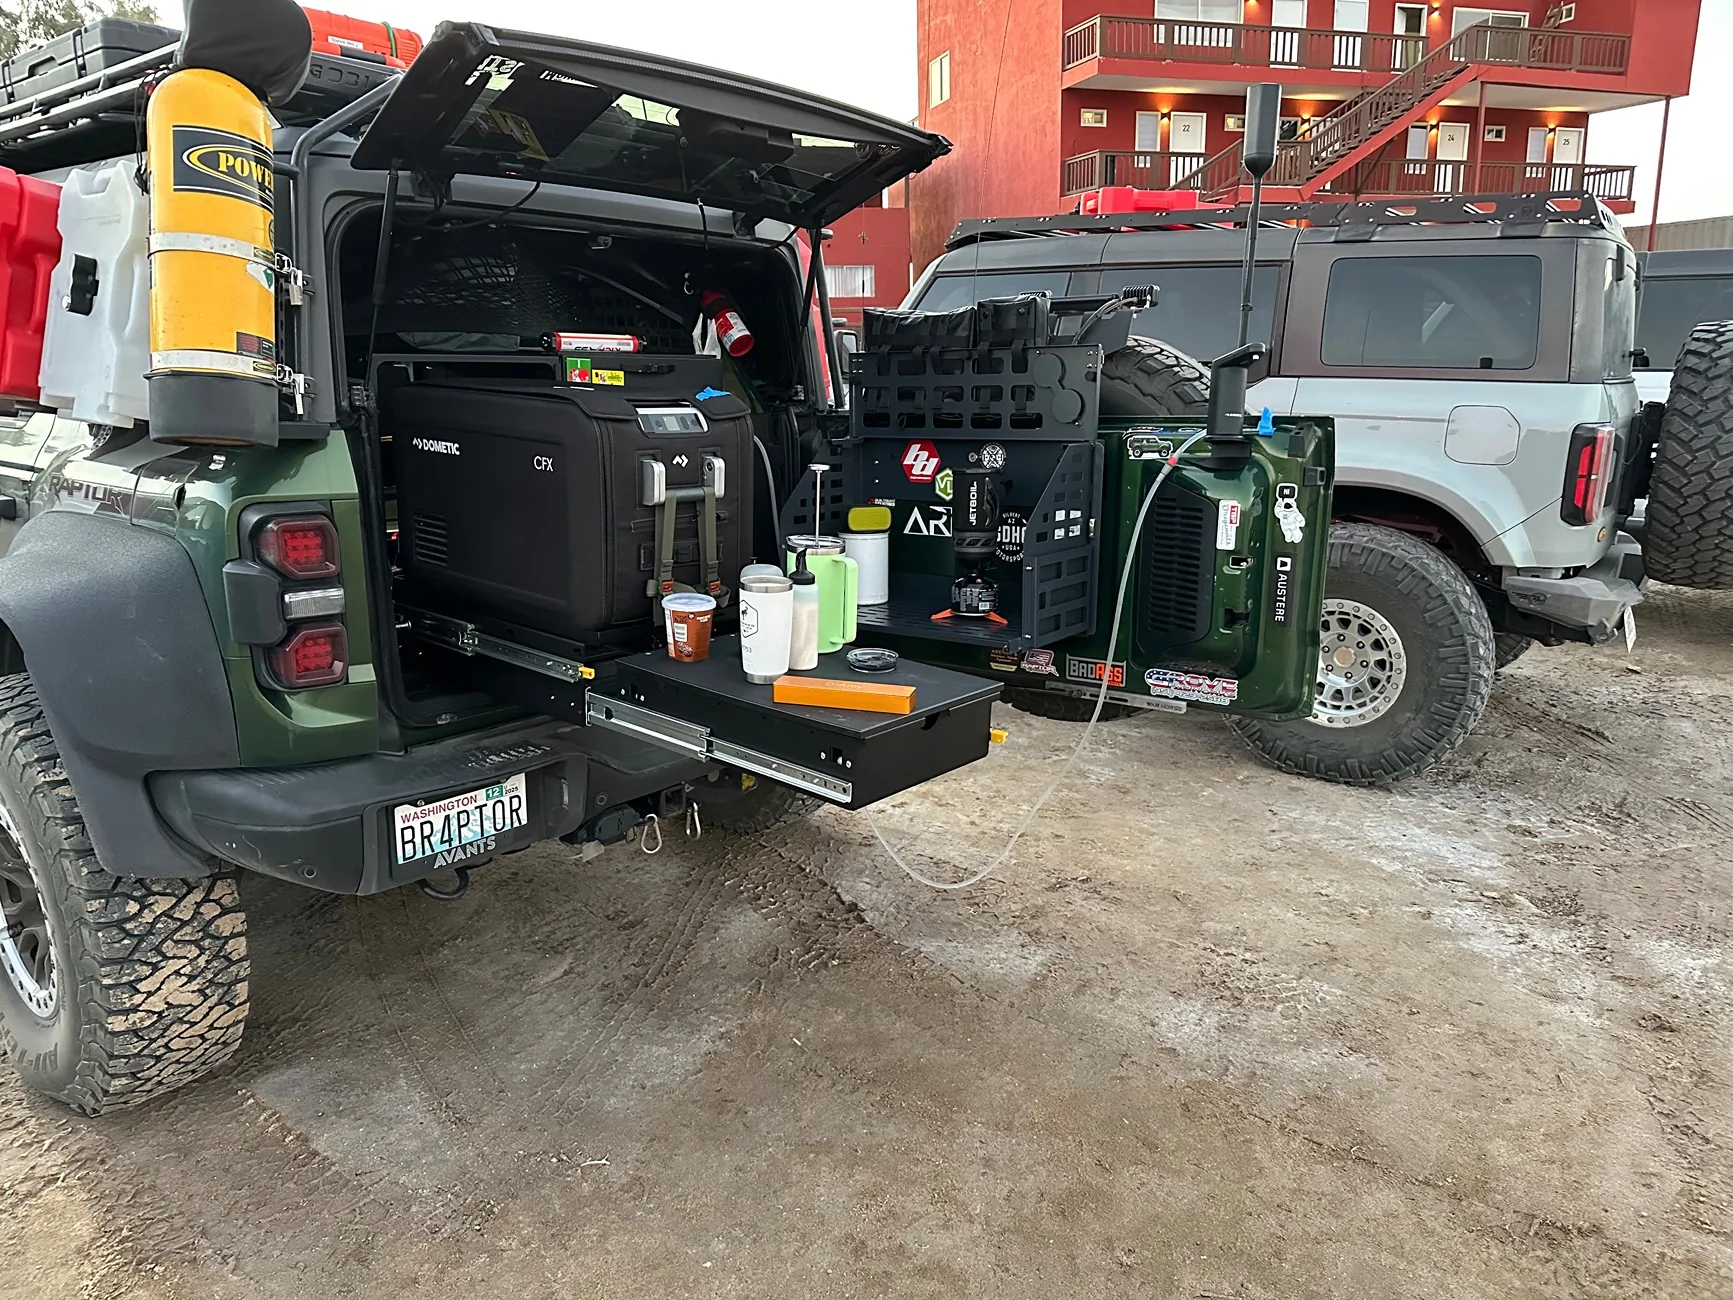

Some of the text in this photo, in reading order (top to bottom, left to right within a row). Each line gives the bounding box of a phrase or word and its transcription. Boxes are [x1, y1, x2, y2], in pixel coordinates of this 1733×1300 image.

[1182, 124, 1190, 132] 22
[1563, 138, 1570, 146] 25
[217, 152, 274, 193] POWE
[422, 438, 460, 455] DOMETIC
[533, 455, 554, 471] CFX
[49, 475, 124, 516] RAPTOR
[969, 480, 977, 526] JETBOIL
[996, 547, 1024, 562] OTORSPOR
[1275, 573, 1288, 622] AUSTERE
[825, 680, 864, 690] D'Arcy
[1145, 669, 1237, 692] GROVE
[487, 787, 500, 798] 12
[504, 786, 519, 795] 2025
[400, 794, 478, 824] WASHINGTON
[400, 794, 522, 862] BR4PTOR
[433, 836, 496, 869] AVANTS
